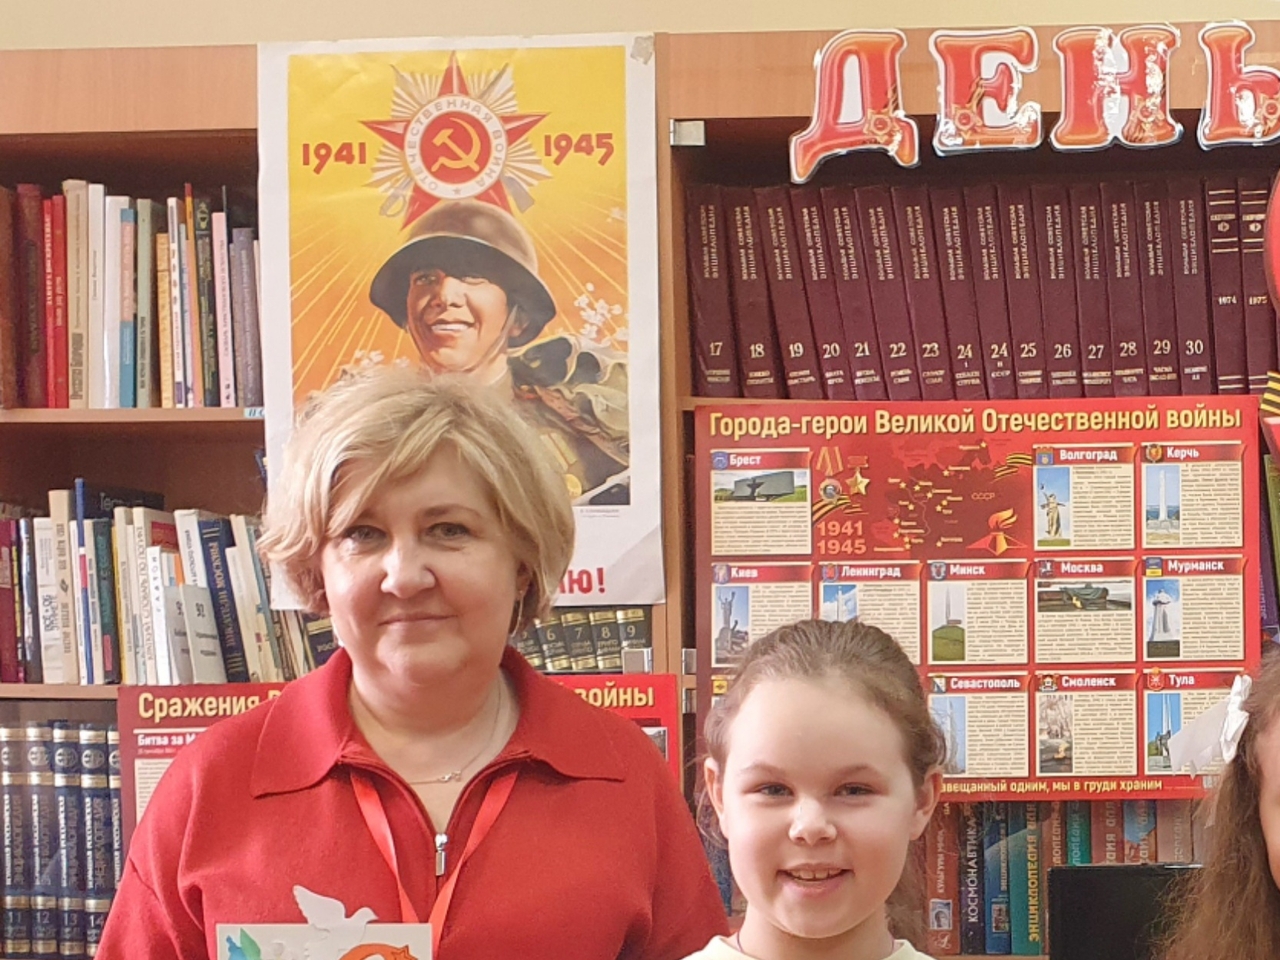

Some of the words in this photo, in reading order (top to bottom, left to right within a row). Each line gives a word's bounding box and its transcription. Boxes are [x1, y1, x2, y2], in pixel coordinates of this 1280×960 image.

[544, 133, 614, 166] 1945
[302, 142, 366, 175] 1941
[709, 342, 723, 356] 17
[751, 343, 764, 358] 18
[789, 342, 804, 357] 19
[823, 343, 840, 358] 20
[855, 342, 870, 357] 21
[890, 343, 907, 358] 22
[922, 343, 939, 358] 23
[957, 344, 973, 359] 24
[991, 343, 1008, 358] 24
[1020, 342, 1037, 358] 25
[1054, 343, 1071, 359] 26
[1088, 345, 1104, 359] 27
[1119, 342, 1137, 357] 28
[1153, 340, 1171, 355] 29
[1185, 340, 1203, 355] 30
[710, 410, 867, 441] Города-герои
[874, 408, 975, 435] Великой
[981, 404, 1160, 434] Отечественной
[1166, 403, 1242, 429] войны
[730, 454, 761, 467] Брест
[1060, 448, 1118, 462] Волгоград
[1166, 447, 1200, 460] Керчь
[817, 521, 864, 536] 1941
[817, 539, 867, 555] 1945
[731, 567, 758, 578] Киев
[841, 565, 902, 579] Ленинград
[950, 564, 986, 576] Минск
[1060, 562, 1104, 574] Москва
[1167, 560, 1225, 573] Мурманск
[602, 627, 611, 639] 8
[626, 625, 636, 637] 9
[950, 677, 1021, 690] Севастополь
[1061, 675, 1117, 688] Смоленск
[1168, 674, 1196, 686] Тула
[138, 692, 260, 723] Сражения
[137, 734, 169, 746] Битва
[171, 735, 183, 746] за
[1052, 781, 1070, 791] мы
[1073, 781, 1080, 790] в
[1084, 780, 1116, 793] груди
[1119, 779, 1162, 791] храним
[966, 819, 979, 923] КОСМОНАВТИКА
[1026, 835, 1040, 943] ЭНЦИКЛОПЕДИЯ
[35, 909, 50, 924] 12
[63, 911, 77, 926] 13
